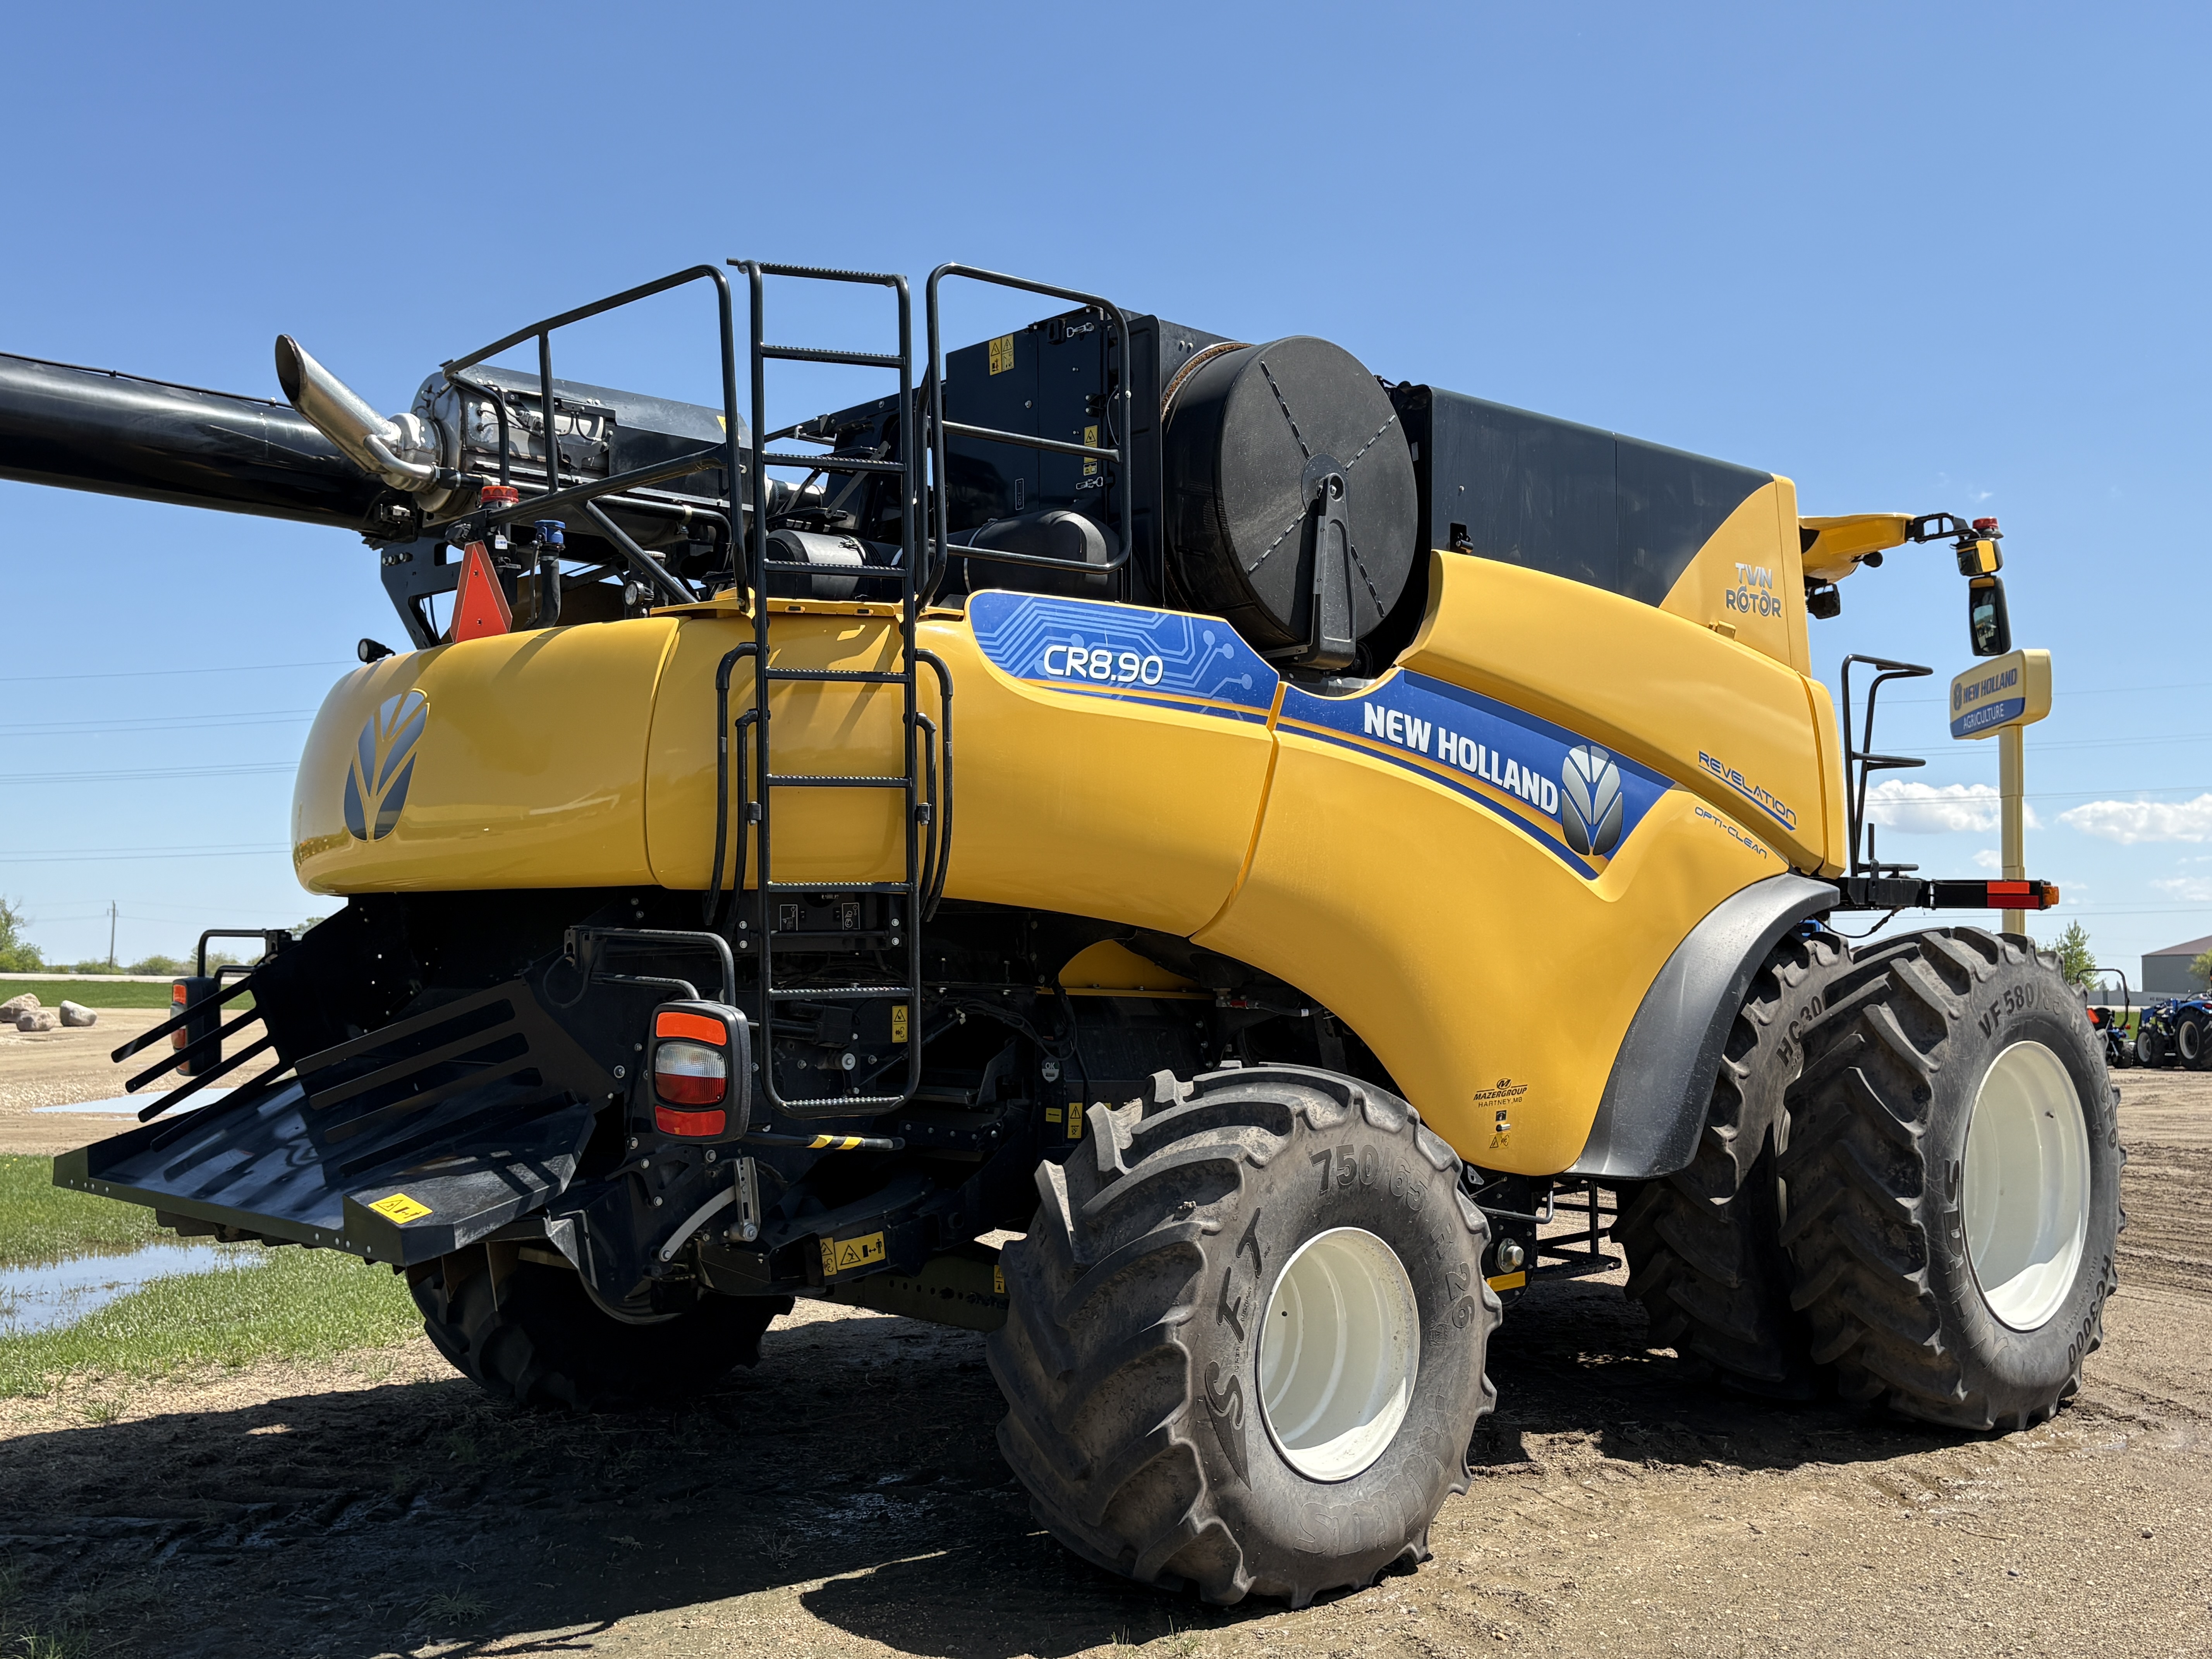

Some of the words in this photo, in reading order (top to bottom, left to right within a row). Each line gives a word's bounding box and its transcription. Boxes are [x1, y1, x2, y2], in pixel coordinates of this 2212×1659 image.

[1726, 585, 1781, 618] ROTOR
[1043, 644, 1163, 685] CR8.90
[1963, 682, 1980, 704] NEW
[1981, 668, 2017, 697] HOLLAND
[1963, 703, 2004, 730] AGRICULTURE
[1364, 702, 1431, 753] NEW
[1438, 726, 1558, 815] HOLLAND
[1698, 750, 1796, 825] REVELATION
[1695, 807, 1767, 859] OPTI-CLEAN
[1978, 1000, 2001, 1040] VF
[1473, 1087, 1527, 1101] MAZERGROUP
[1309, 1144, 1429, 1211] 750/65
[1431, 1215, 1456, 1259] R
[1446, 1261, 1475, 1329] 26
[2068, 1254, 2112, 1365] HC3000
